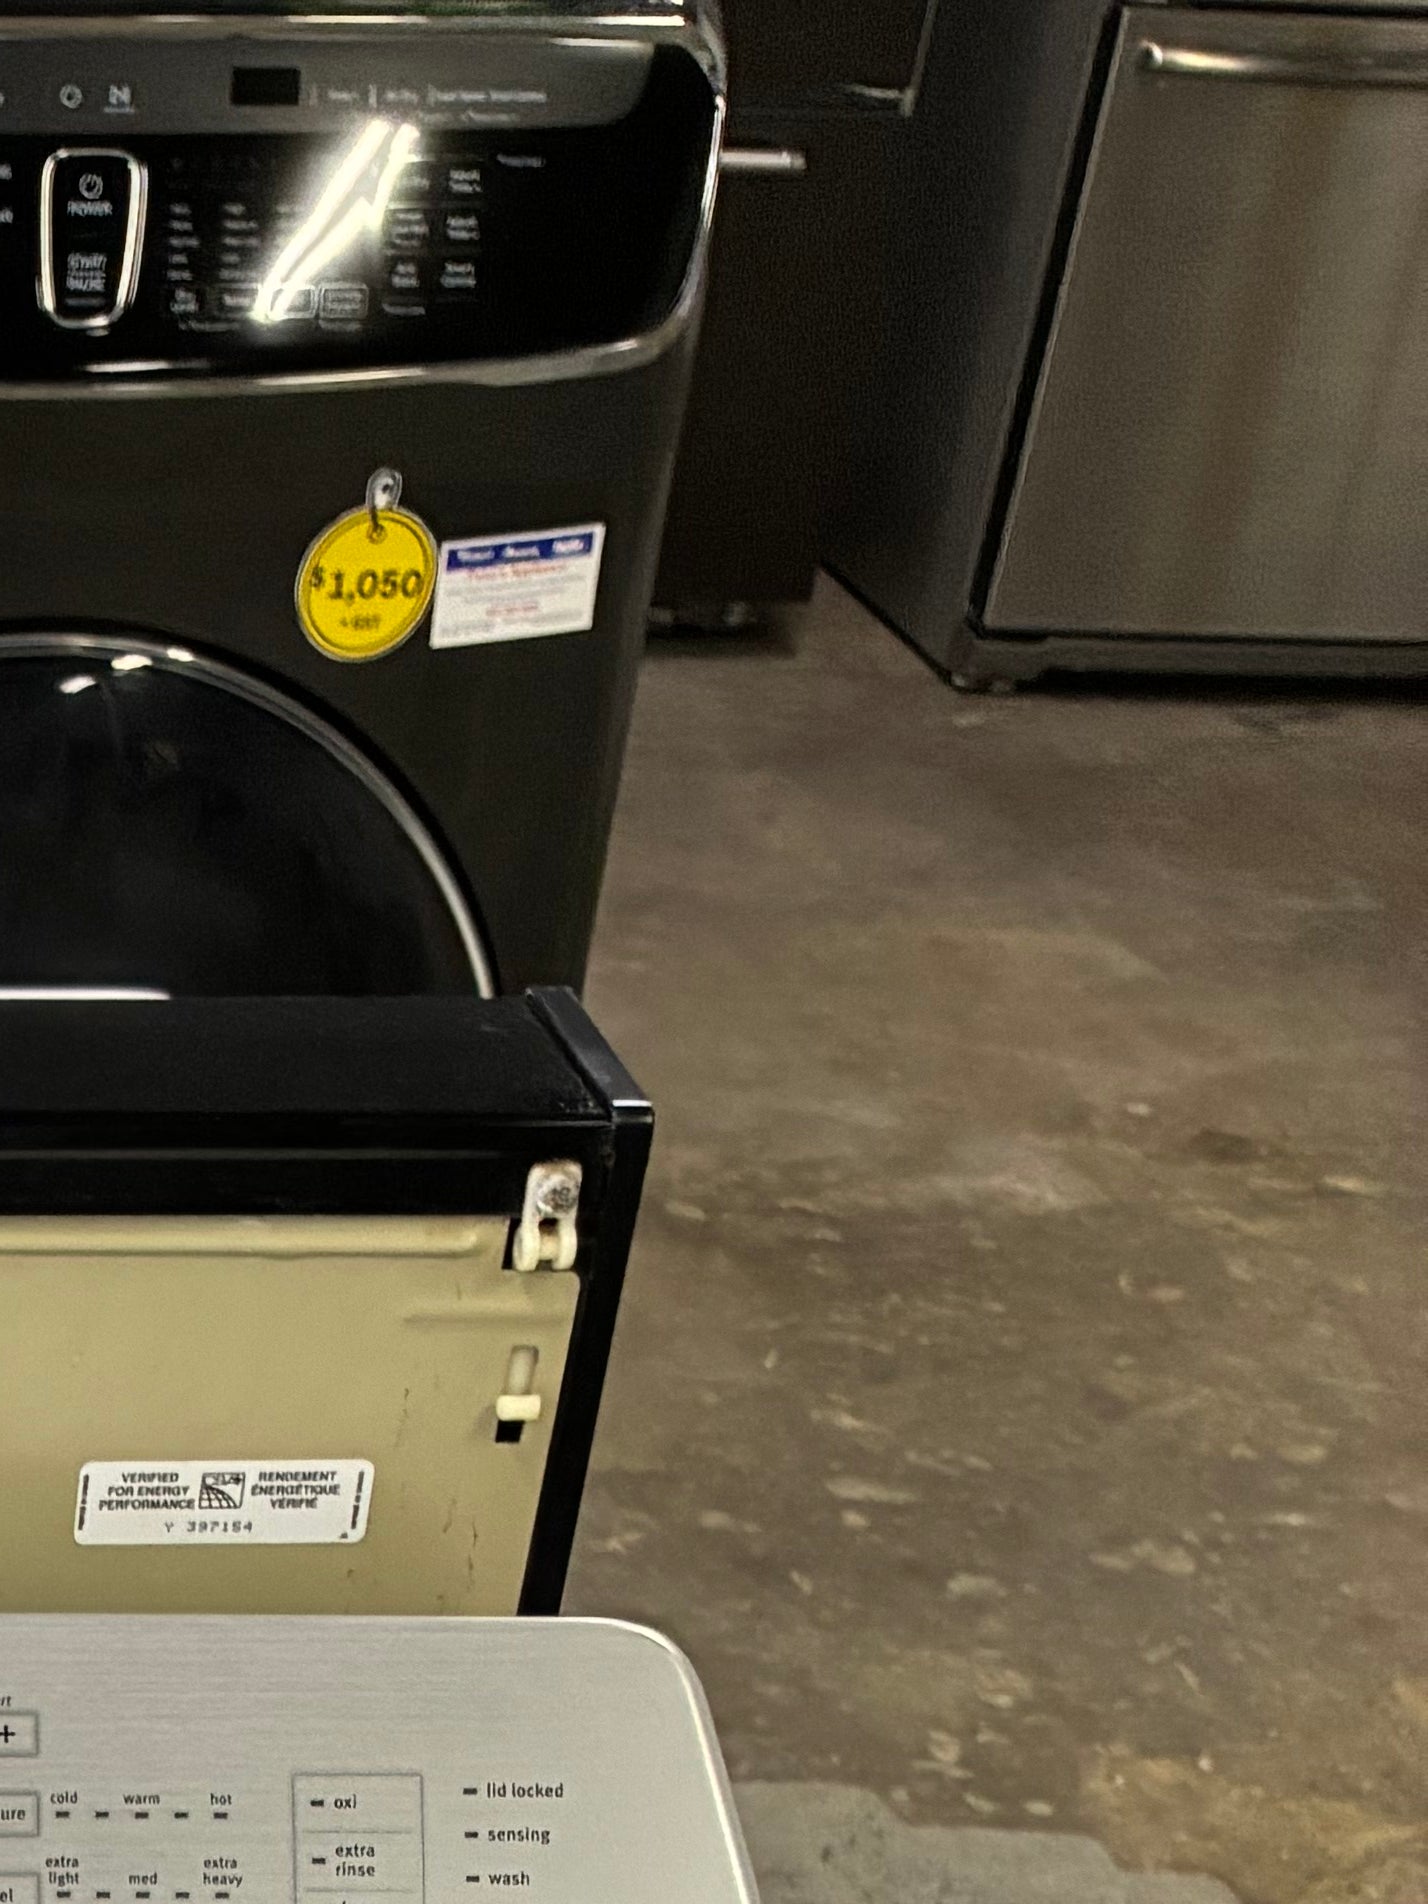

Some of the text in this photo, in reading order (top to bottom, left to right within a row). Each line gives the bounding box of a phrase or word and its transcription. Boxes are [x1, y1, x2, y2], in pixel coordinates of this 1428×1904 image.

[309, 563, 424, 607] $1,050
[121, 1472, 179, 1483] VERIFIED
[258, 1471, 337, 1482] RENDEMENT
[107, 1485, 190, 1497] FOR ENERGY
[98, 1498, 195, 1511] PERFORMANCE
[50, 1791, 232, 1806] cold warm hot
[486, 1781, 565, 1800] lid locked
[487, 1826, 551, 1847] sensing
[334, 1843, 376, 1860] extra
[45, 1856, 80, 1869] extra
[203, 1857, 238, 1870] extra
[334, 1860, 375, 1878] rinse
[48, 1870, 243, 1888] light med heavy
[489, 1870, 531, 1888] wash
